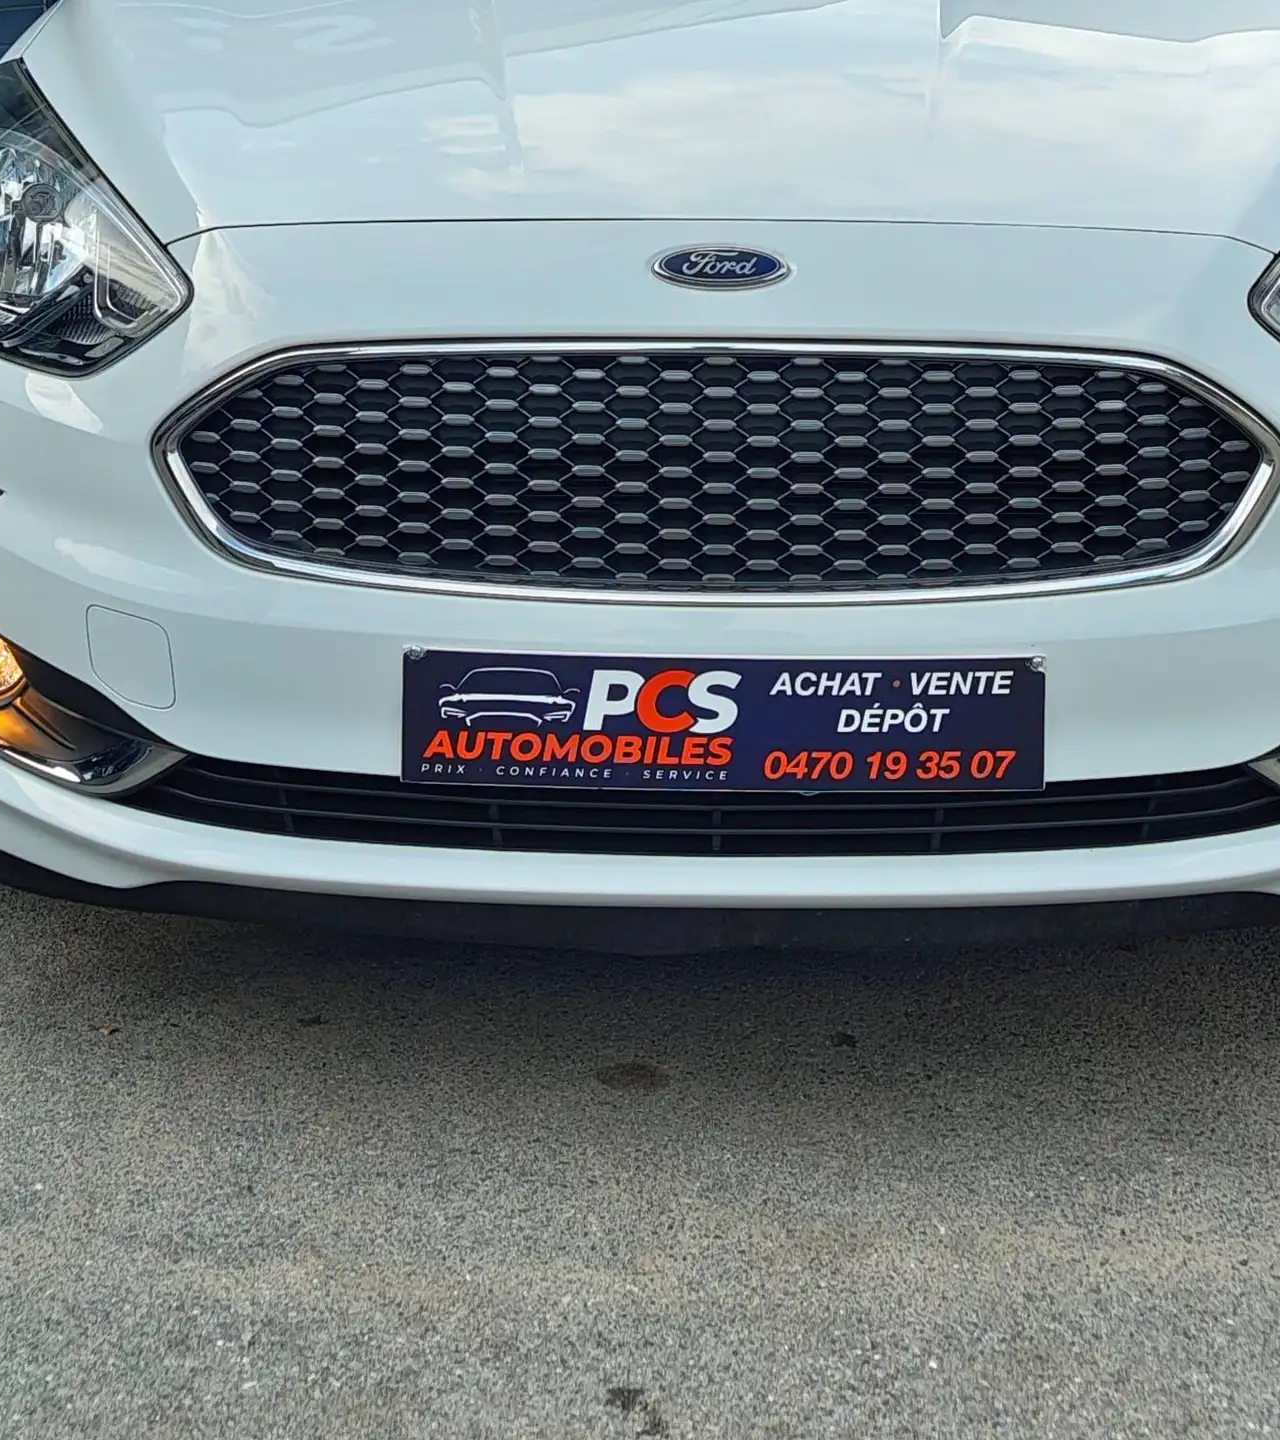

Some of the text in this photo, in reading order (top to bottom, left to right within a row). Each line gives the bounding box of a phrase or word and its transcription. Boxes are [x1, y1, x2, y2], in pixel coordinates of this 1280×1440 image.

[682, 250, 758, 275] Ford
[769, 670, 1014, 696] ACHAT VENTE
[583, 669, 742, 734] PCS
[837, 703, 950, 733] DÉPÔT
[423, 730, 734, 765] AUTOMOBILES
[420, 763, 729, 780] PRIX CONFIANCE SERVICE
[764, 750, 1016, 780] 0470 19 35 07
